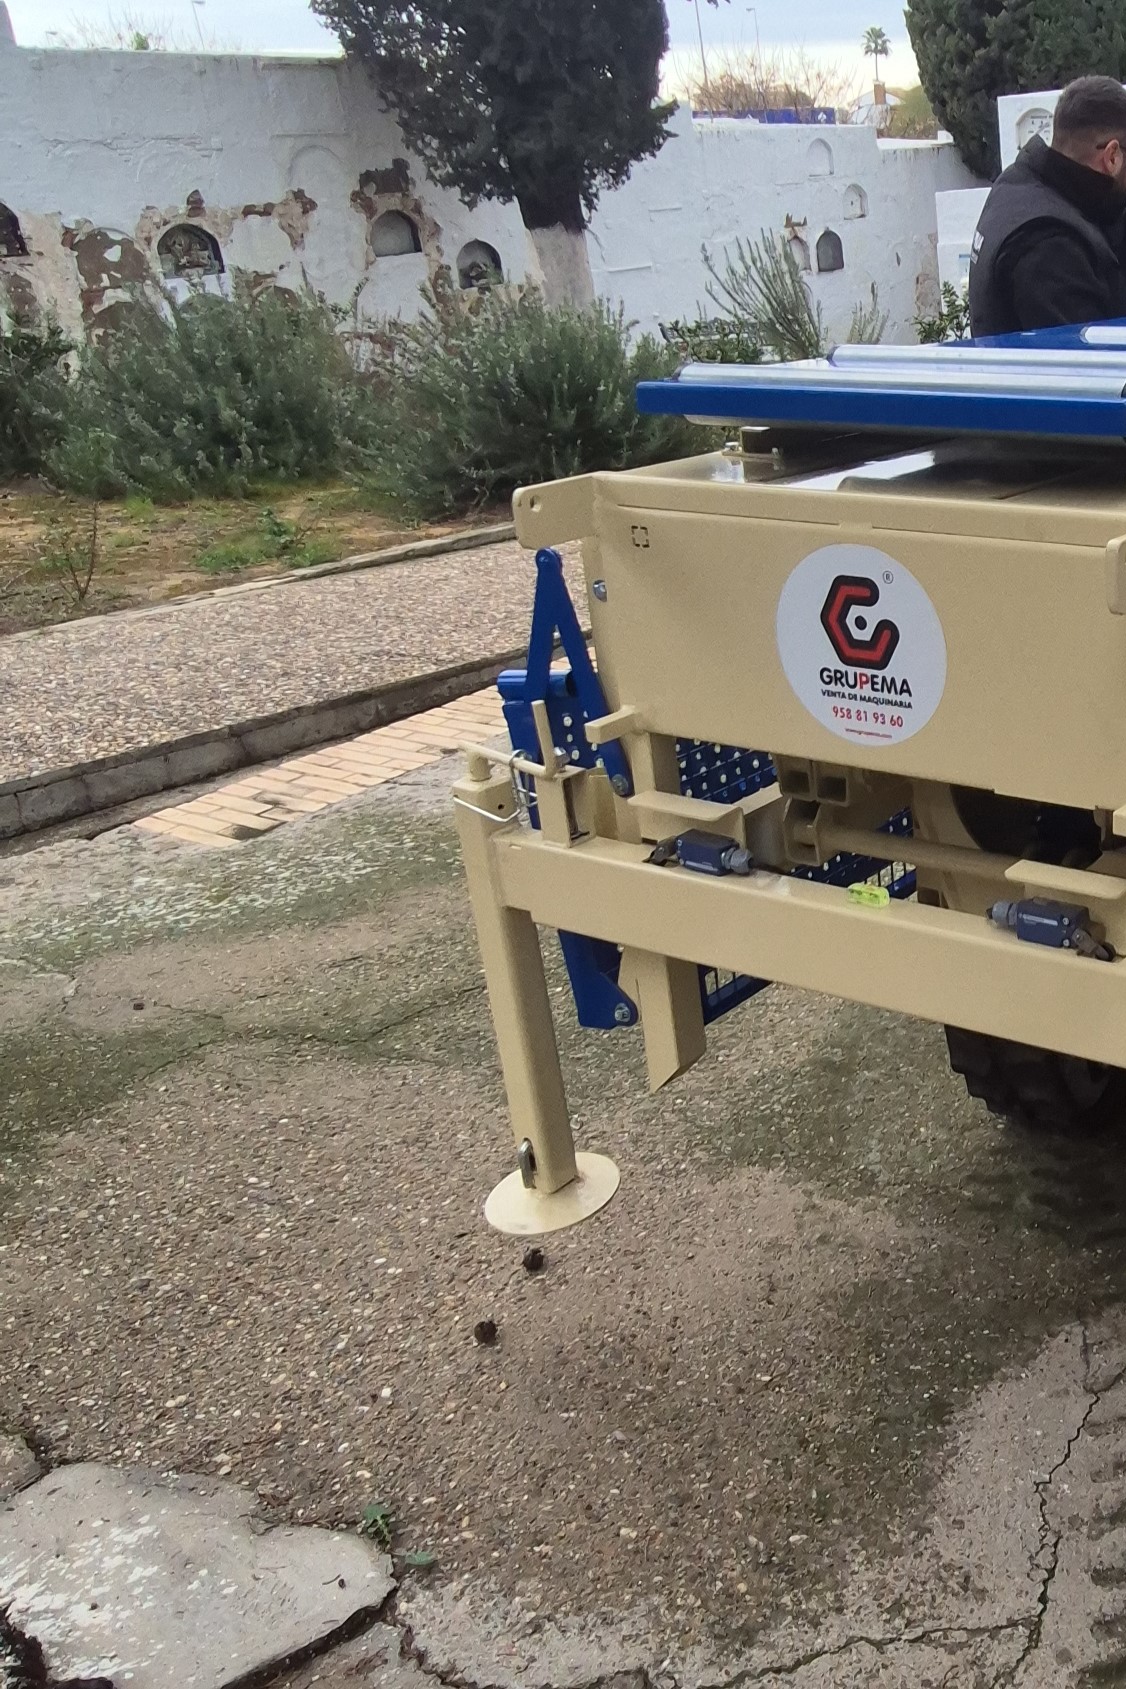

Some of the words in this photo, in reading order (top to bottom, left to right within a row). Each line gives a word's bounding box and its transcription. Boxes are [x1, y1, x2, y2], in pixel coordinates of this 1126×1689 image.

[819, 667, 913, 697] GRUPEMA
[821, 688, 846, 699] VENTA
[848, 693, 858, 701] DE
[860, 695, 912, 709] MAQUINARIA
[832, 705, 852, 720] 958
[856, 709, 868, 722] 81
[873, 712, 886, 725] 93
[889, 714, 904, 728] 60
